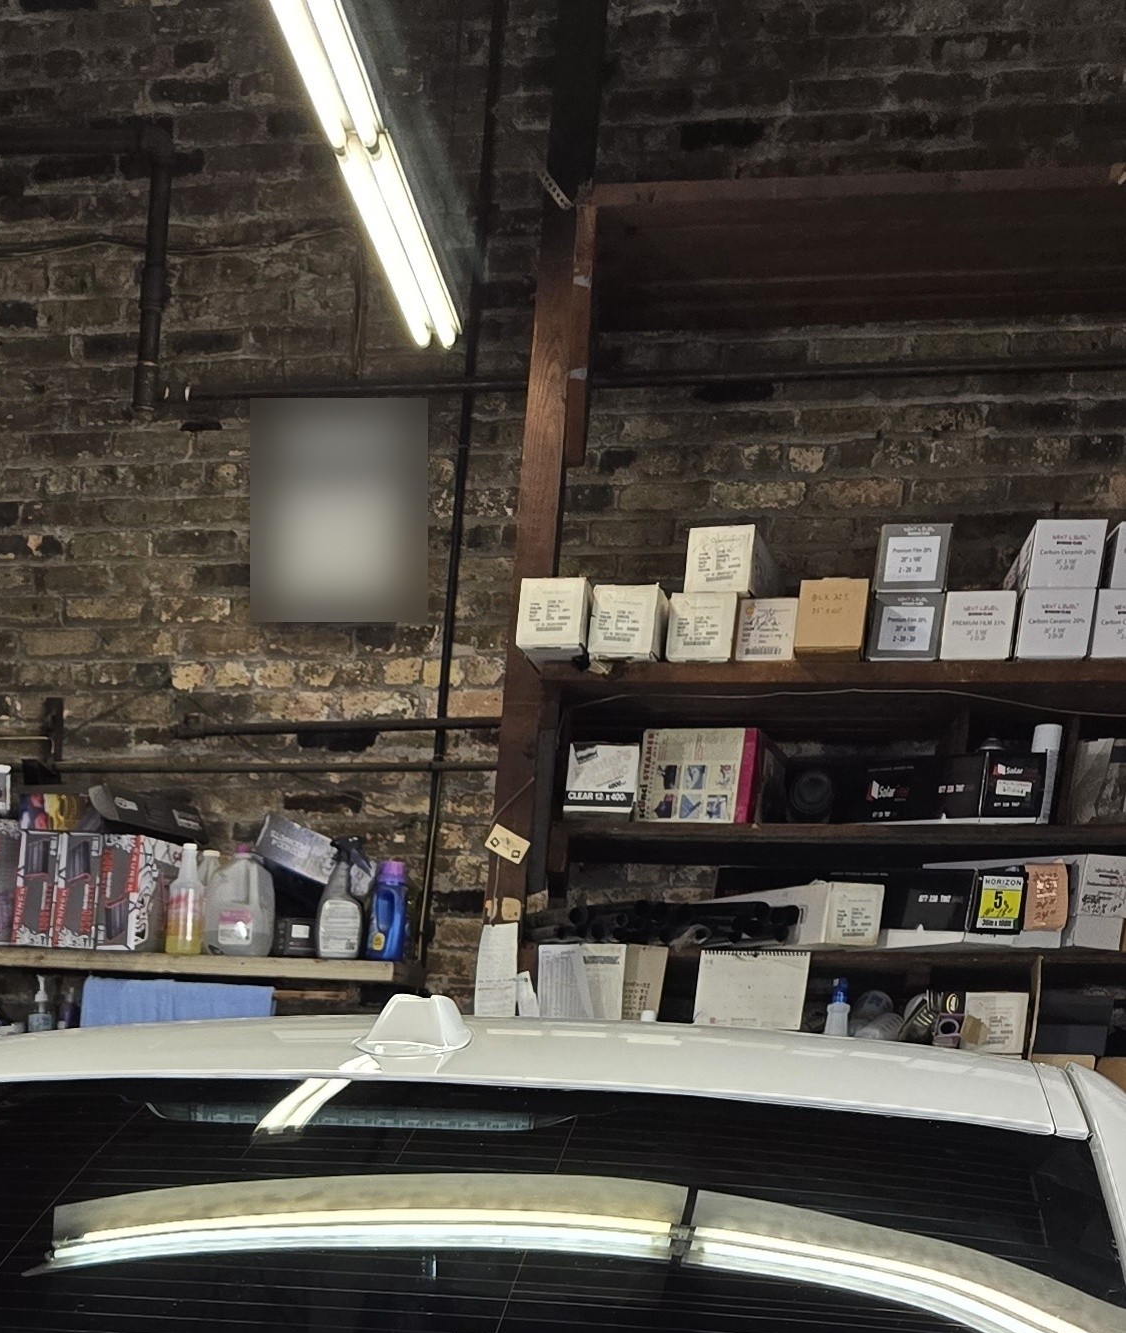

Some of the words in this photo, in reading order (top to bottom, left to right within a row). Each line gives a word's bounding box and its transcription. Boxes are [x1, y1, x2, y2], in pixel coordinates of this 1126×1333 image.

[642, 732, 655, 781] STEAMER
[567, 792, 593, 801] CLEAR
[127, 847, 138, 892] CRUNCH
[985, 878, 1022, 886] HORIZON
[13, 886, 26, 931] CRUNCH
[54, 887, 67, 932] CRUNCH
[993, 891, 1003, 909] 5
